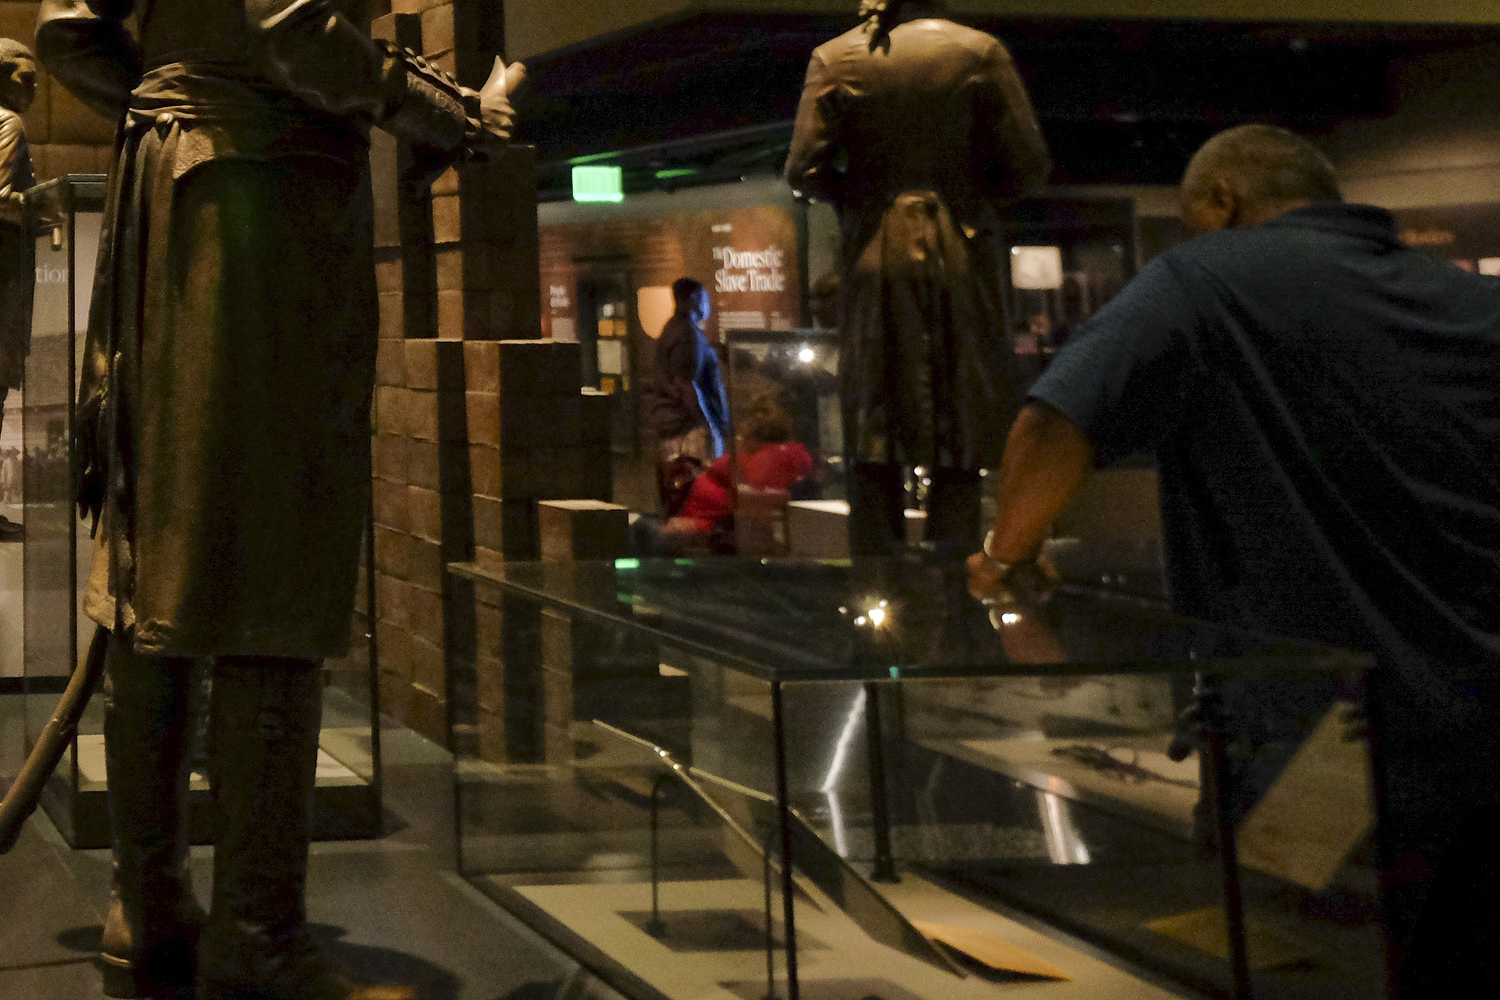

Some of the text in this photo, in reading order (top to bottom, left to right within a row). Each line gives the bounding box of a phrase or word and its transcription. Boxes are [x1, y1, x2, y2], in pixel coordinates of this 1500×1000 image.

[722, 245, 785, 269] Domestic
[715, 266, 786, 293] Slave Trade
